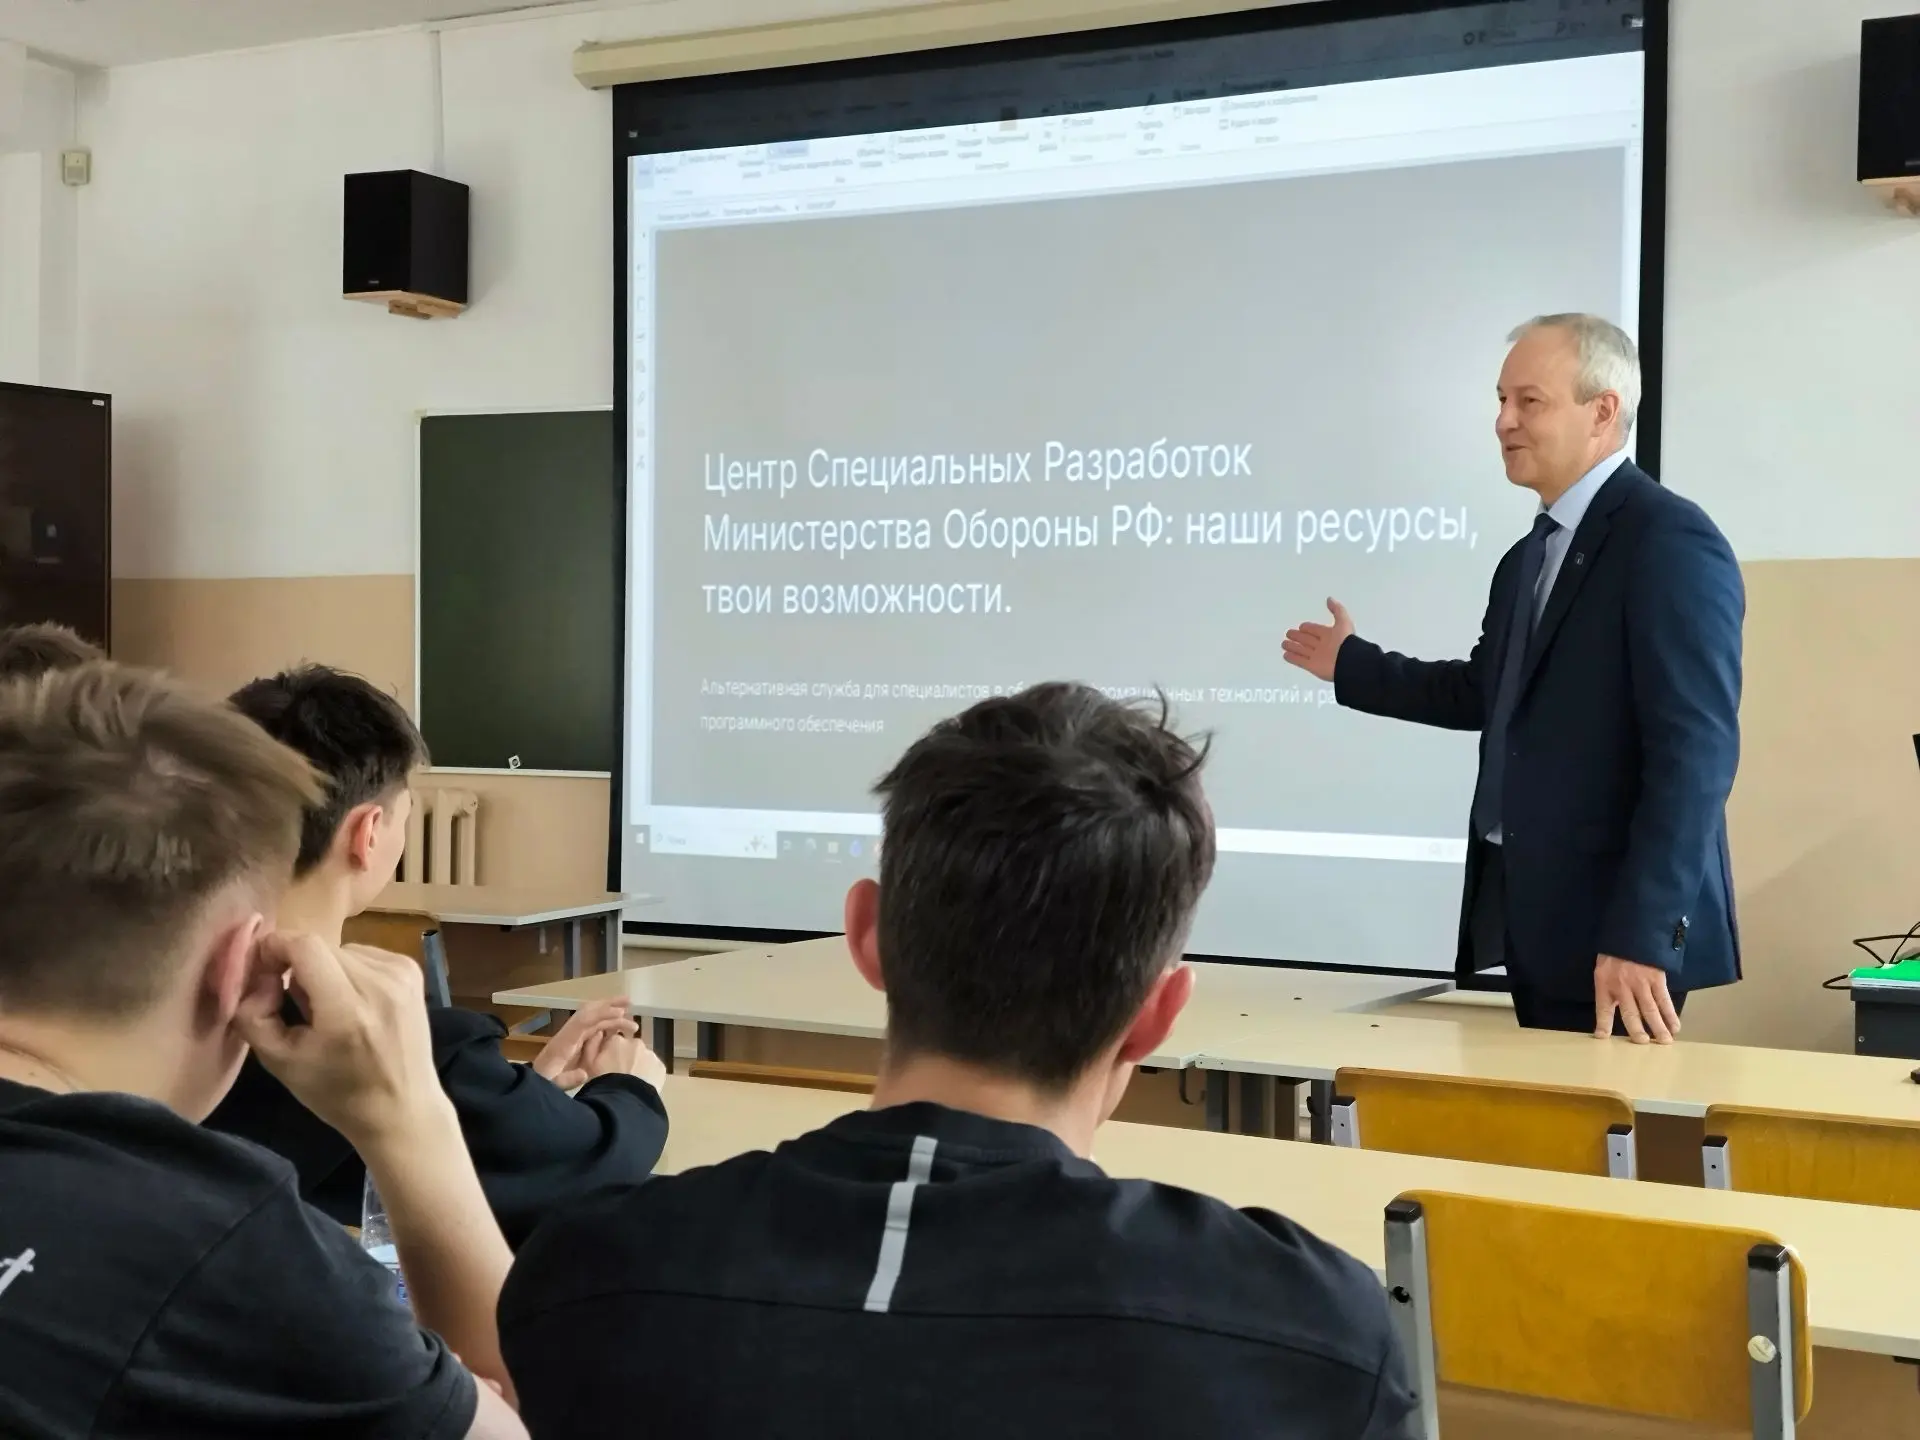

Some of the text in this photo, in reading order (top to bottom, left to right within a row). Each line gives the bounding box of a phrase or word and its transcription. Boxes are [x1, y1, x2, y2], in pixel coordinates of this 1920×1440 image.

[705, 437, 1252, 499] Центр Специальных Разработок
[704, 501, 1478, 560] Министерства Обороны РФ: наши ресурсы,
[702, 583, 1012, 614] твои возможности.
[701, 679, 808, 697] Альтернативная
[811, 680, 860, 699] служба
[863, 684, 890, 699] для
[892, 684, 990, 700] специалистов
[1209, 685, 1300, 703] технологий
[1304, 689, 1313, 703] и
[701, 714, 885, 734] программного обеспечения
